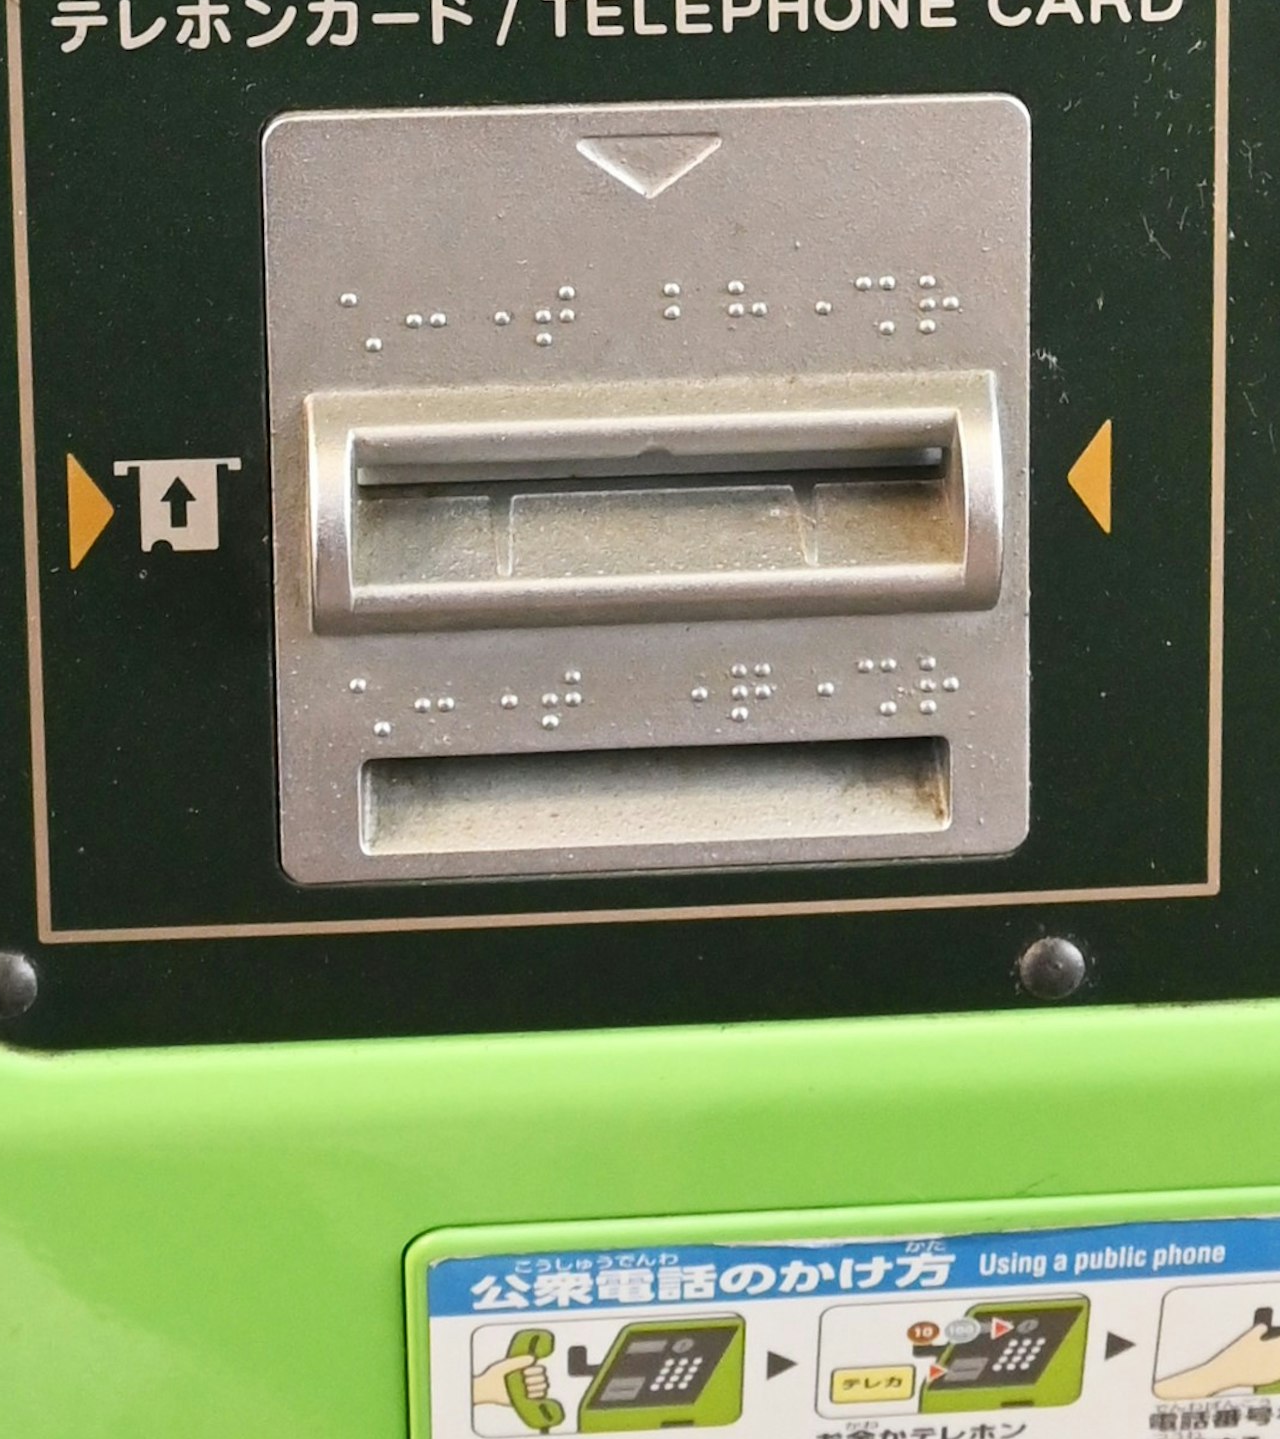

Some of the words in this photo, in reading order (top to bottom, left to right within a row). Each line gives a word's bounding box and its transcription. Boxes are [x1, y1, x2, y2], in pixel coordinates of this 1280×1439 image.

[515, 1253, 679, 1273] こうしゅうでんわ
[979, 1252, 1046, 1277] Using
[1053, 1254, 1068, 1271] a
[1074, 1245, 1146, 1274] public
[1152, 1243, 1226, 1271] phone
[470, 1254, 956, 1311] 公衆電話のかけ方
[914, 1326, 934, 1338] 10
[842, 1375, 904, 1391] テレカ
